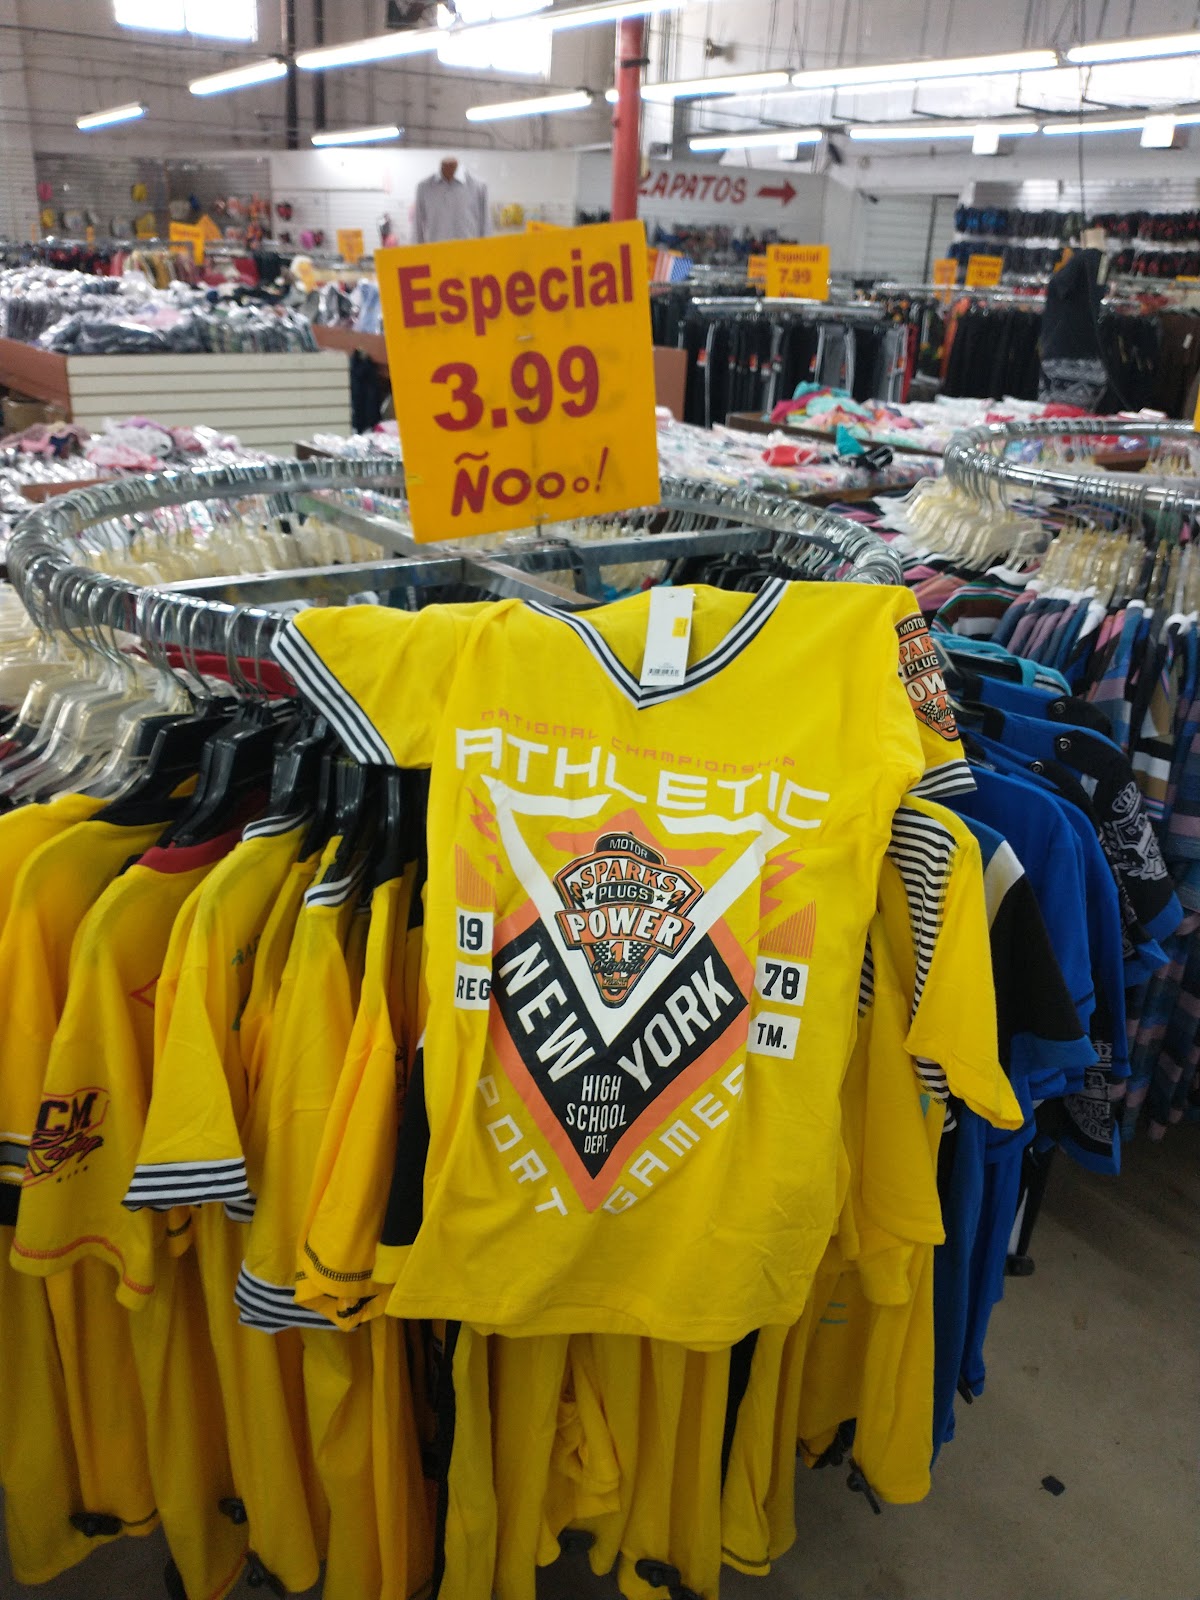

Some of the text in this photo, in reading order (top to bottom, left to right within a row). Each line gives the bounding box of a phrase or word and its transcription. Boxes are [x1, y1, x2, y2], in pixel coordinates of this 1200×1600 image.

[774, 249, 820, 263] Especial
[397, 243, 634, 336] Especial
[430, 345, 600, 432] 3.99
[899, 635, 934, 664] PAR
[907, 655, 939, 676] PLUG
[481, 708, 599, 740] NATIONAL
[455, 727, 830, 830] ATHLETIC
[609, 838, 649, 859] MOTOR
[580, 860, 678, 892] SPARKS
[600, 885, 649, 901] PLUGS
[458, 917, 483, 951] 19
[565, 907, 684, 948] POWER
[456, 975, 492, 1001] REG
[762, 962, 801, 1001] 78
[499, 941, 735, 1092] NEW YORK
[757, 1022, 788, 1050] TM.
[580, 1074, 622, 1102] HIGH
[565, 1102, 628, 1134] SCHOOL
[477, 1074, 568, 1217] PORT
[584, 1134, 609, 1154] DEPT.
